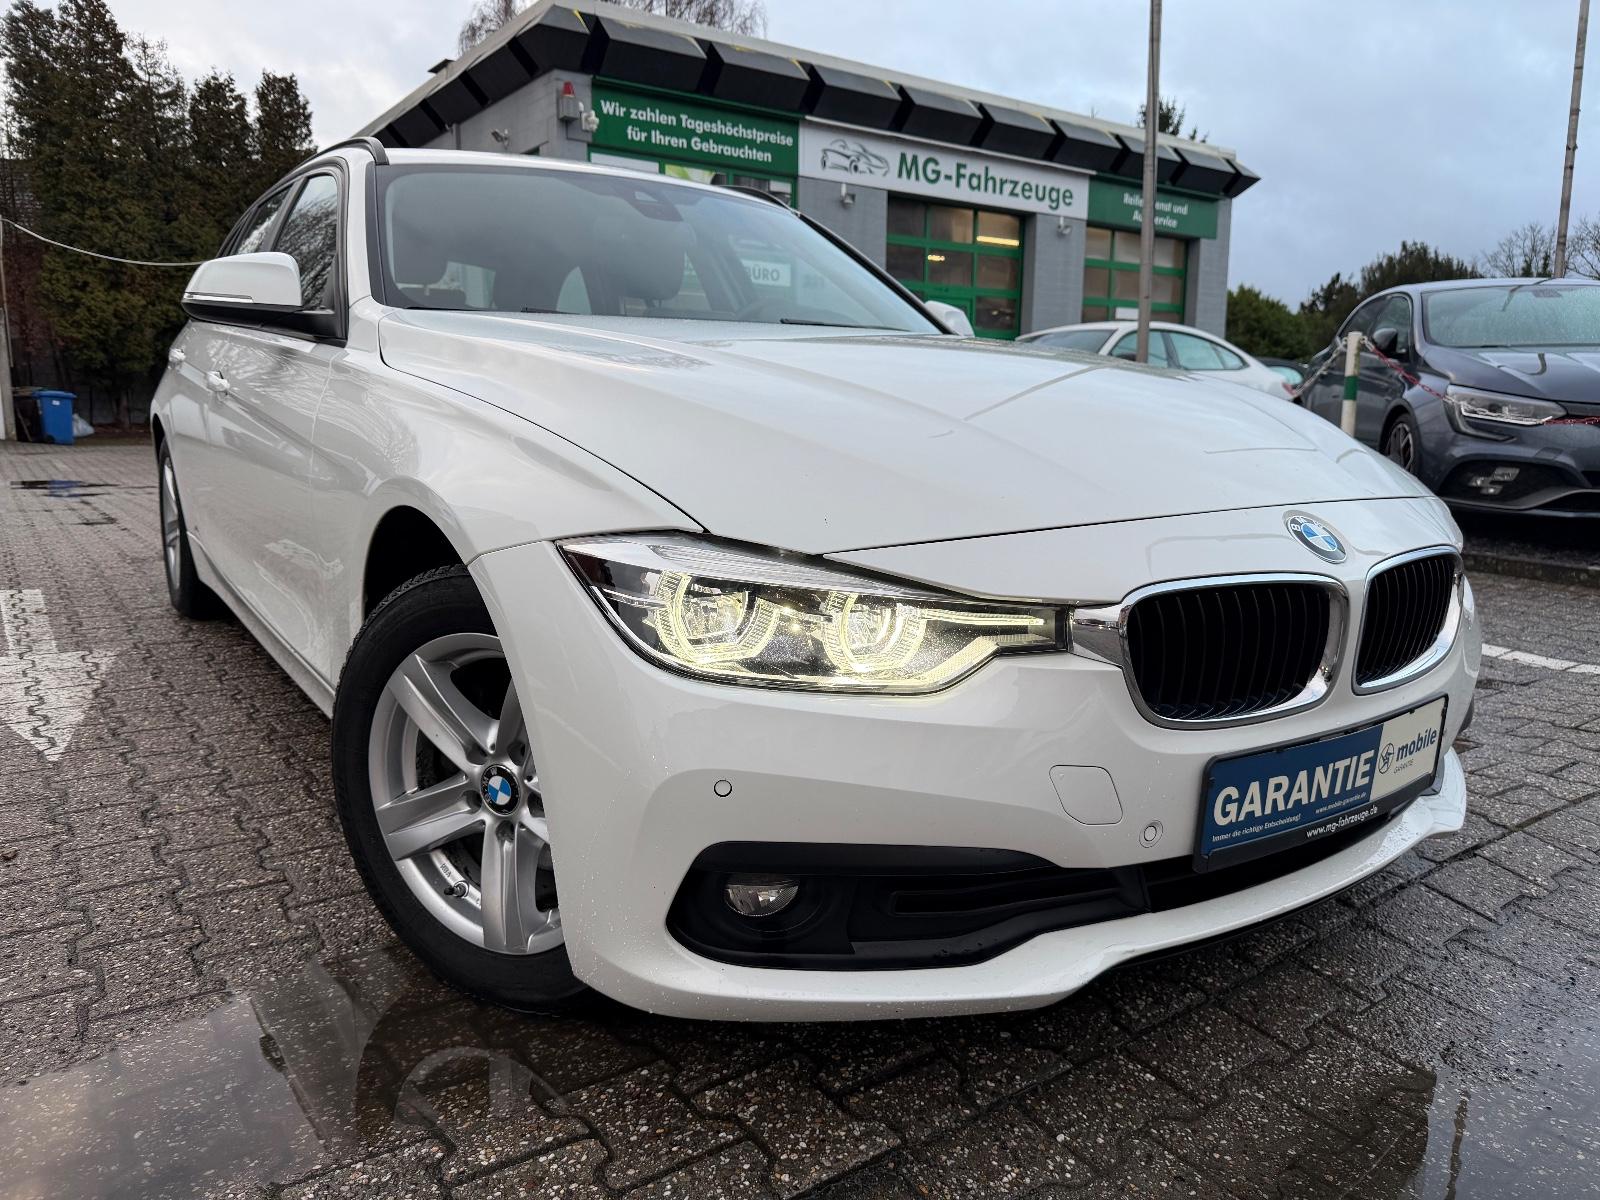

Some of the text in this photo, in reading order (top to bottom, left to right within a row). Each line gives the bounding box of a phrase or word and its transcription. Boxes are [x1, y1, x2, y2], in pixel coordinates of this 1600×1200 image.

[600, 99, 794, 147] Wir zahlen Tageshöchstpreise
[627, 126, 772, 163] für Ihren Gebrauchten
[897, 152, 1073, 211] MG-Fahrzeuge
[1123, 192, 1189, 215] Reifeenst und
[1132, 209, 1178, 228] Auervice
[1396, 727, 1437, 762] mobile
[1213, 749, 1375, 826] GARANTIE
[1212, 812, 1301, 842] Immer die richtige Entscheidung!
[1306, 804, 1378, 838] www.mg-fahrzeuge.de
